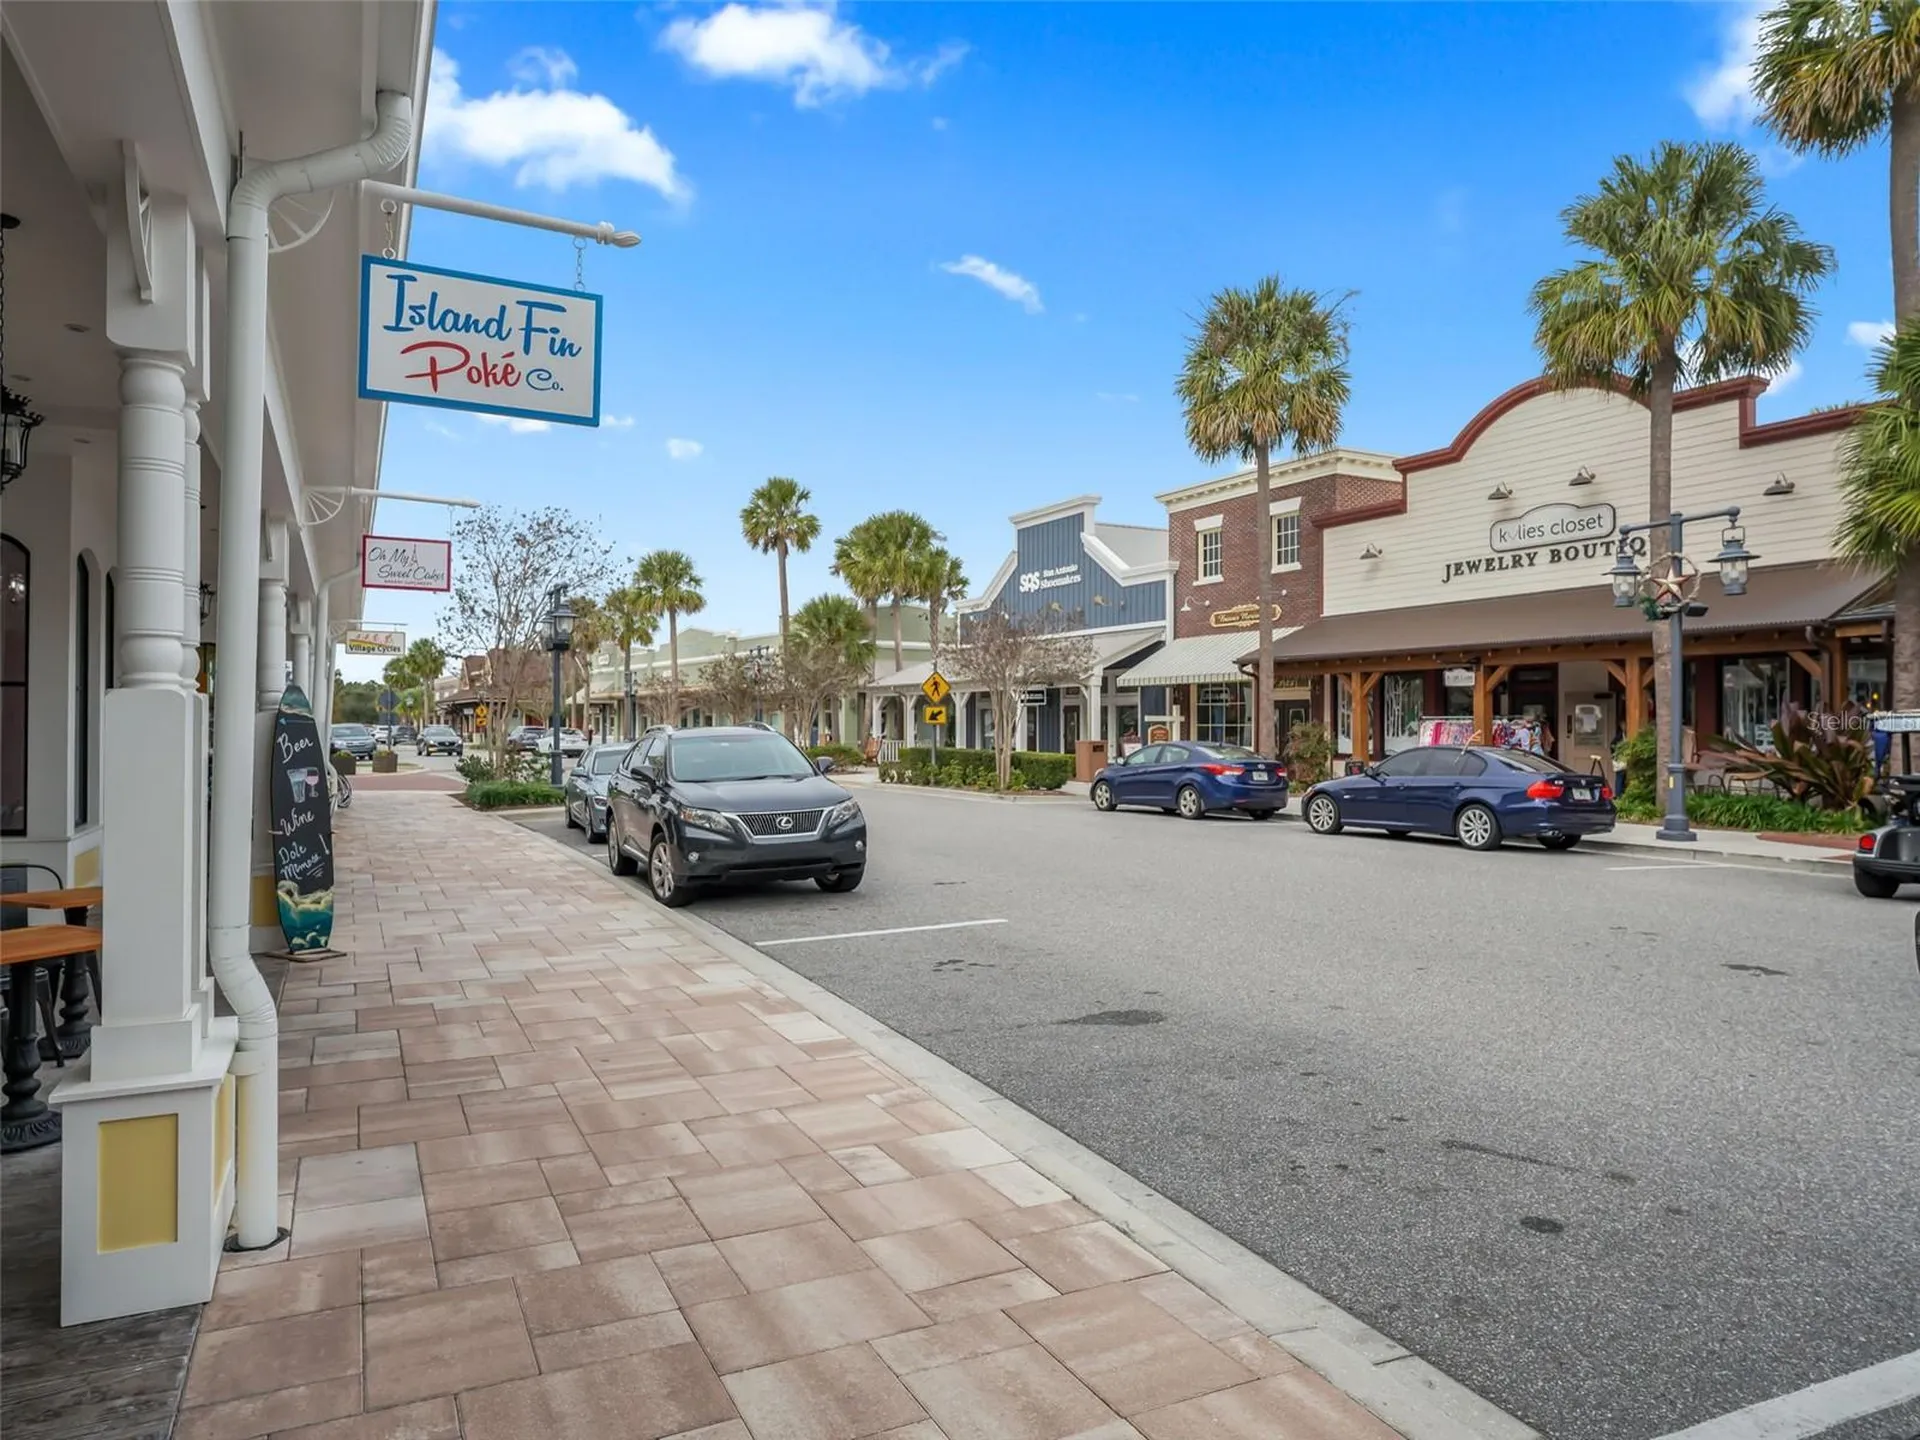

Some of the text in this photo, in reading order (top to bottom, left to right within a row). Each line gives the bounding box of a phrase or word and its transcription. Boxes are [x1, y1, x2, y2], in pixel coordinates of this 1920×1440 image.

[383, 273, 582, 357] Island Fin
[400, 340, 564, 393] Poké Co.
[1550, 513, 1604, 536] closet
[368, 546, 410, 567] Oh My
[1442, 551, 1538, 584] JEWELRY
[377, 564, 412, 579] Sweet
[349, 644, 376, 653] Village
[276, 732, 314, 764] Beer
[280, 807, 315, 836] Wine
